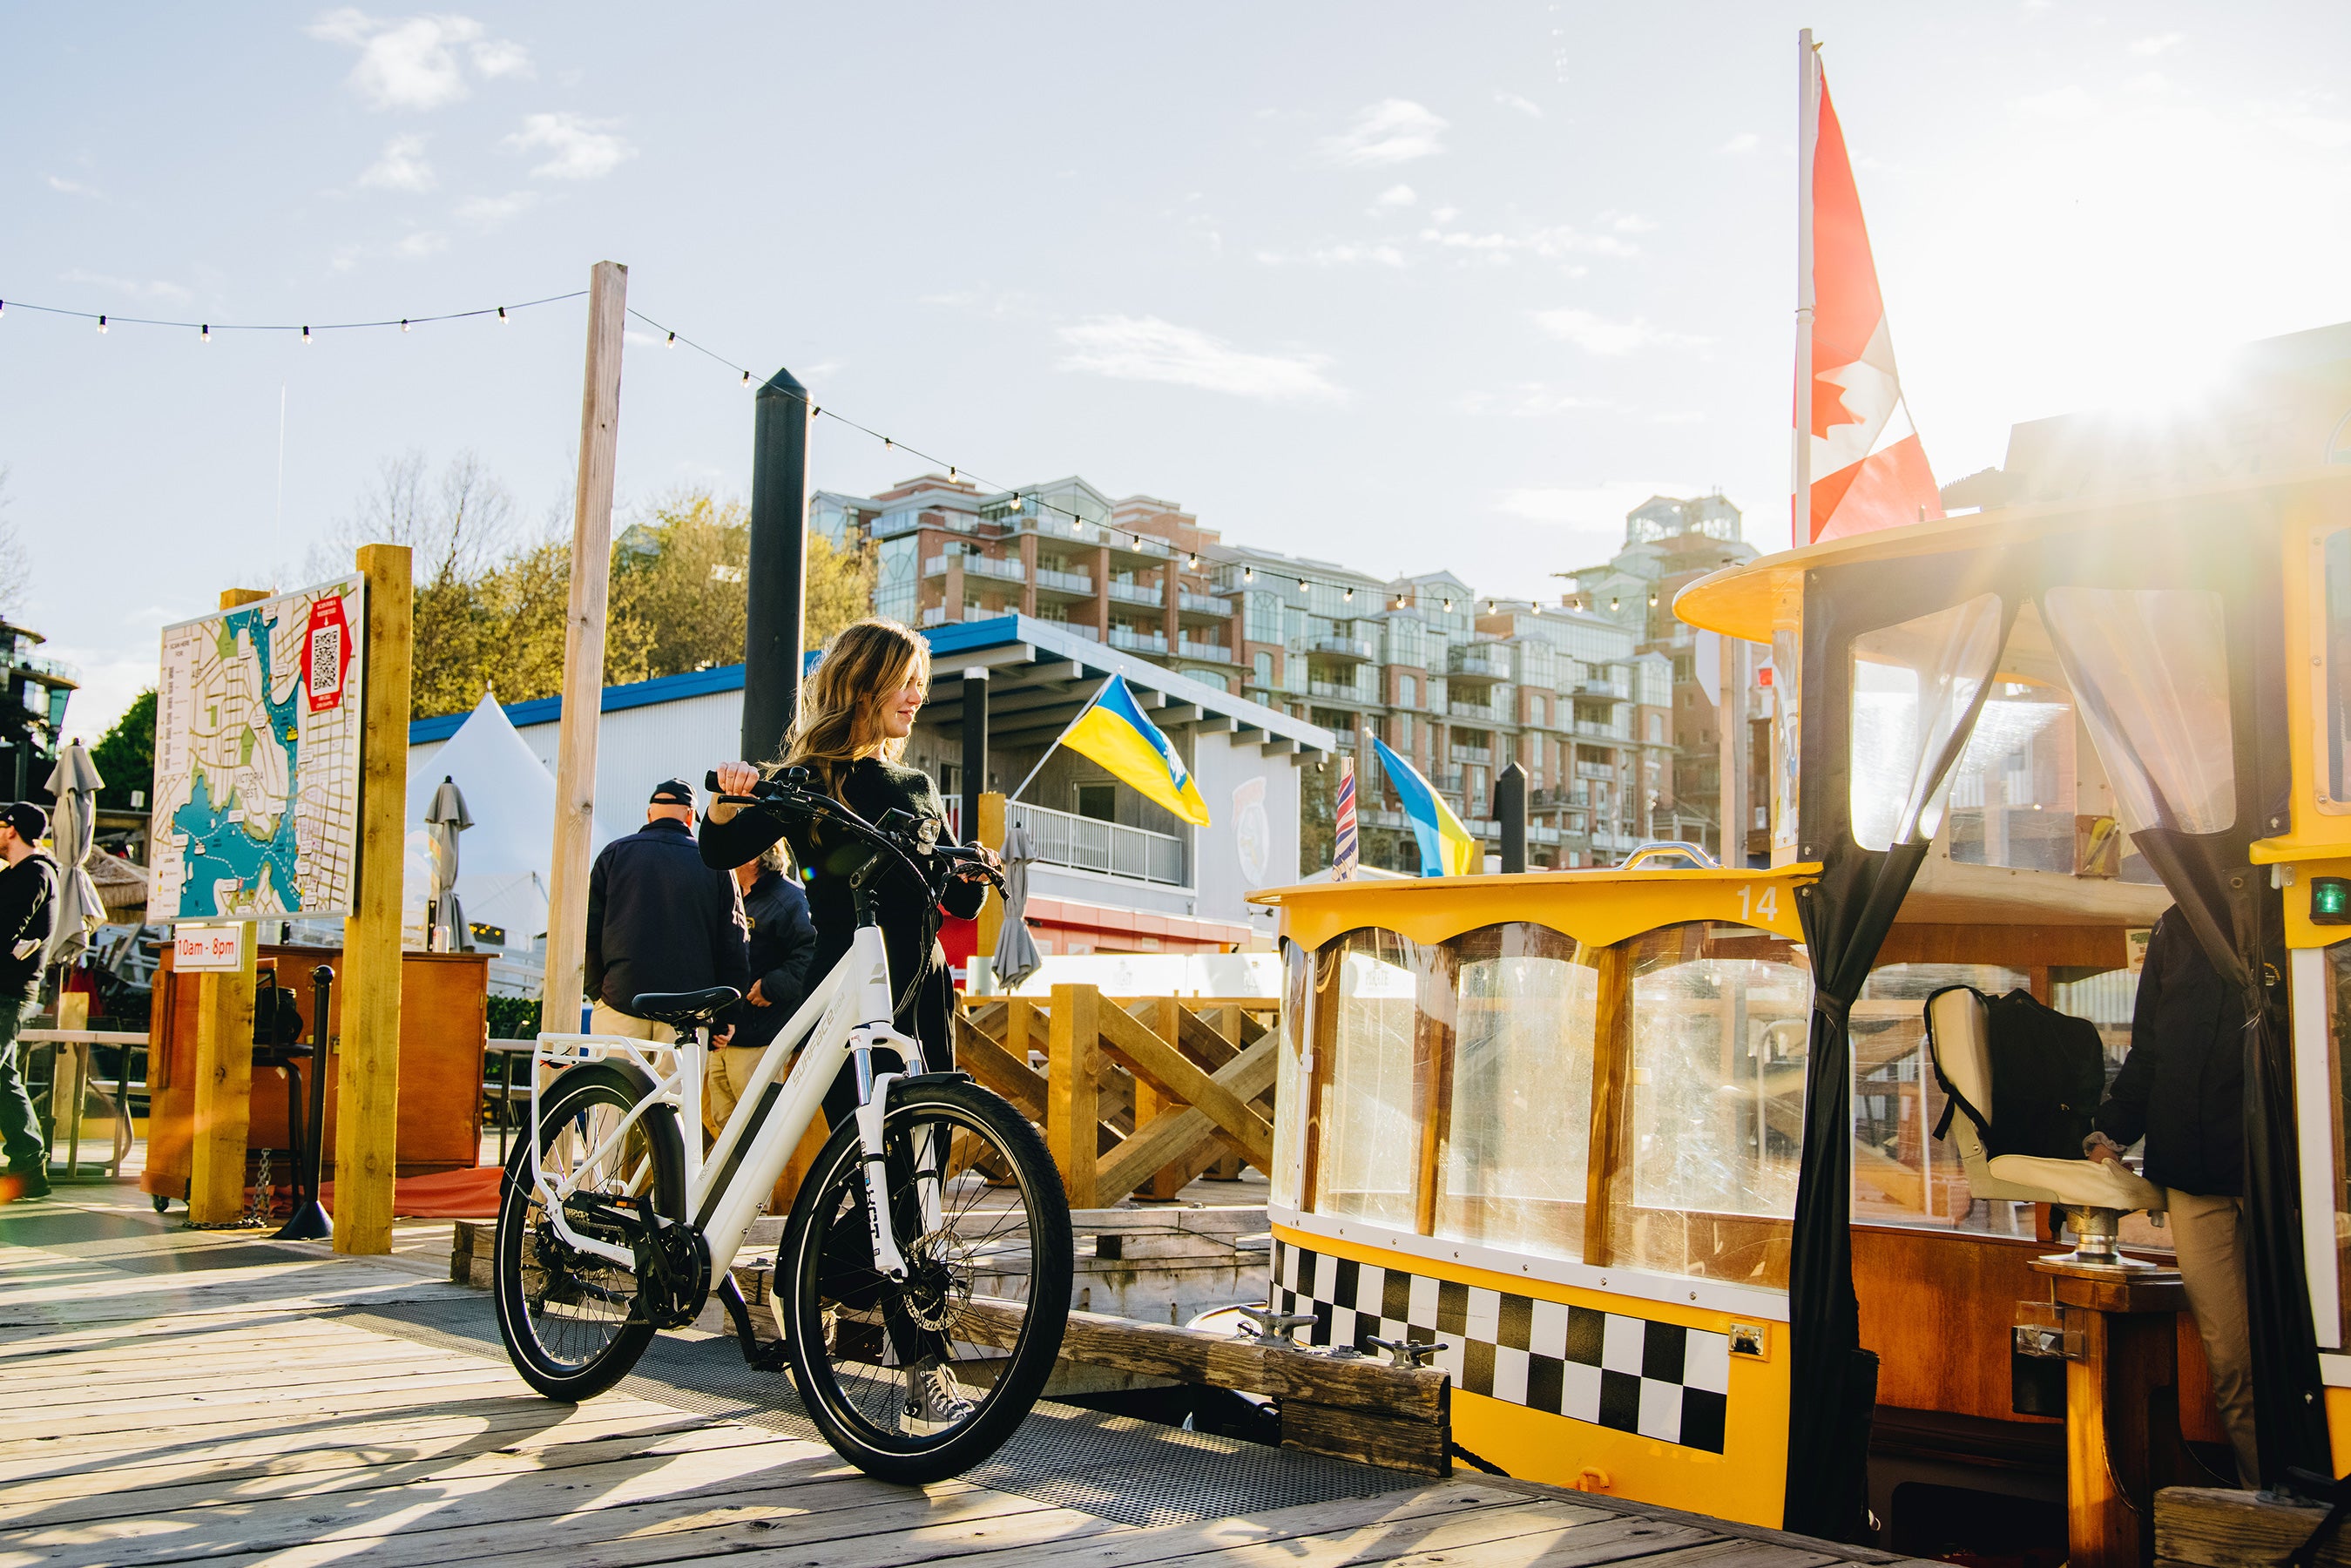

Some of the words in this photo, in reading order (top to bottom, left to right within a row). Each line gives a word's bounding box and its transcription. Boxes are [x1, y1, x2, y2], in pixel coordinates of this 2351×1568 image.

[235, 771, 263, 783] VICTORIA
[1737, 884, 1778, 922] 14
[178, 939, 203, 956] 10am
[213, 937, 234, 959] 8pm
[698, 1161, 713, 1182] ROOK
